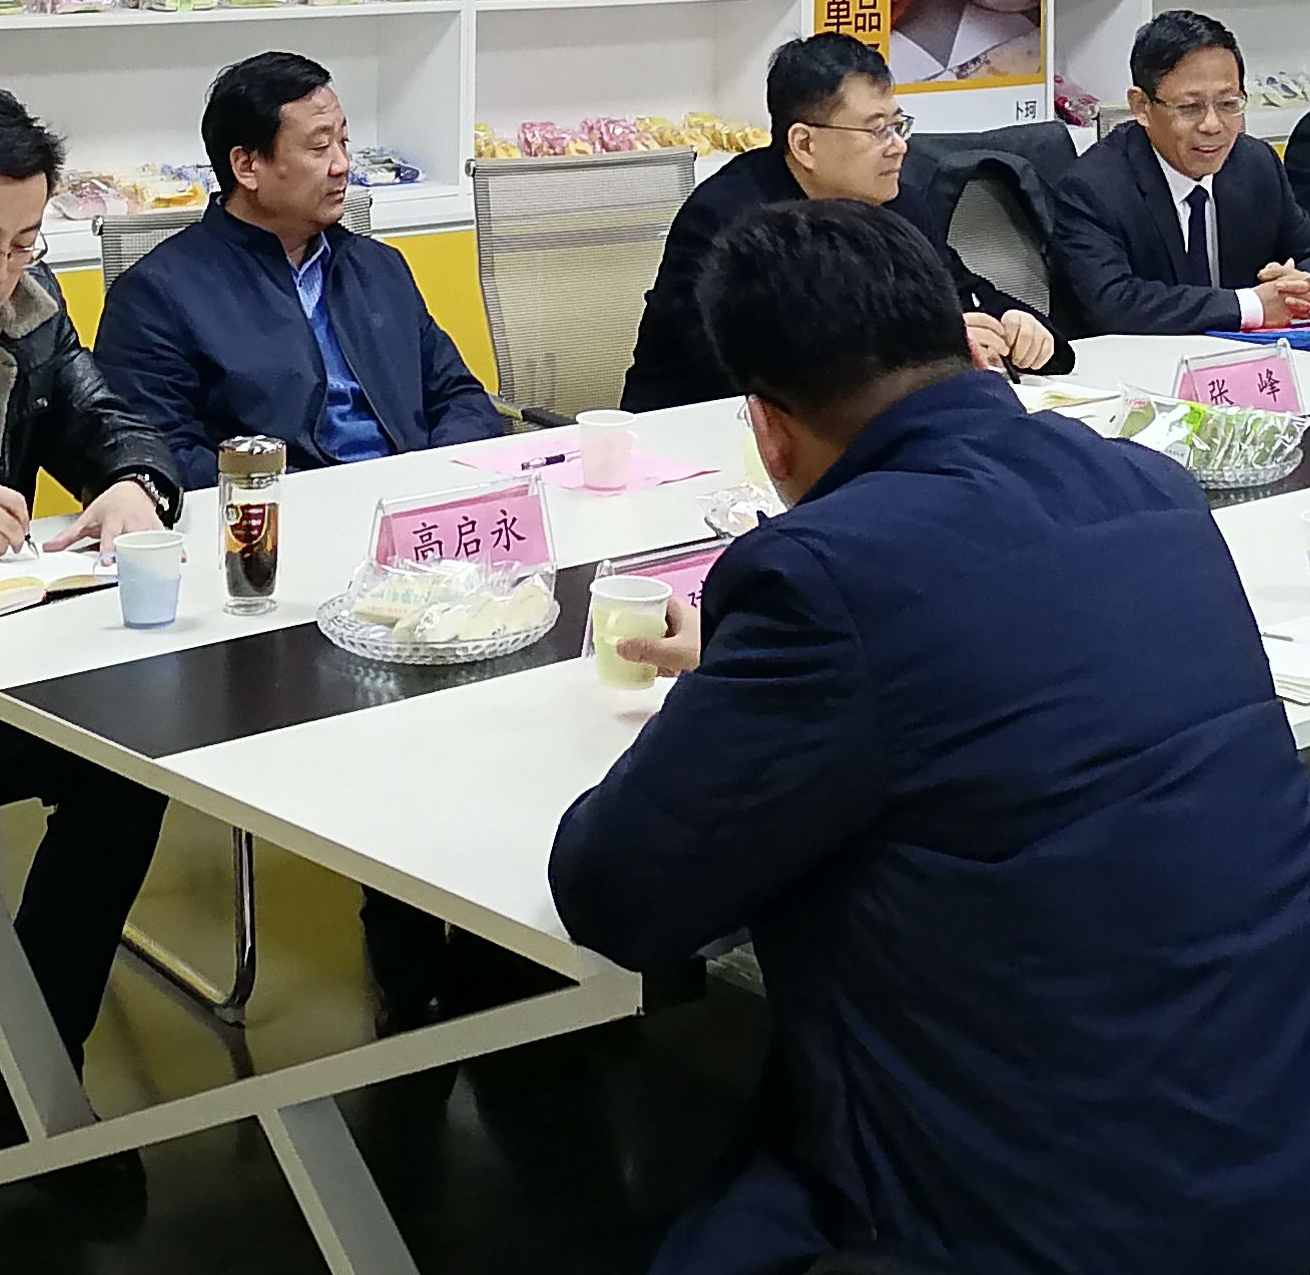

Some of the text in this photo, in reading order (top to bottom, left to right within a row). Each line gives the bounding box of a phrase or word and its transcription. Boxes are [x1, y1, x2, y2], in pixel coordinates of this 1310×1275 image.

[1207, 368, 1281, 406] 张峰
[412, 509, 527, 562] 高启永
